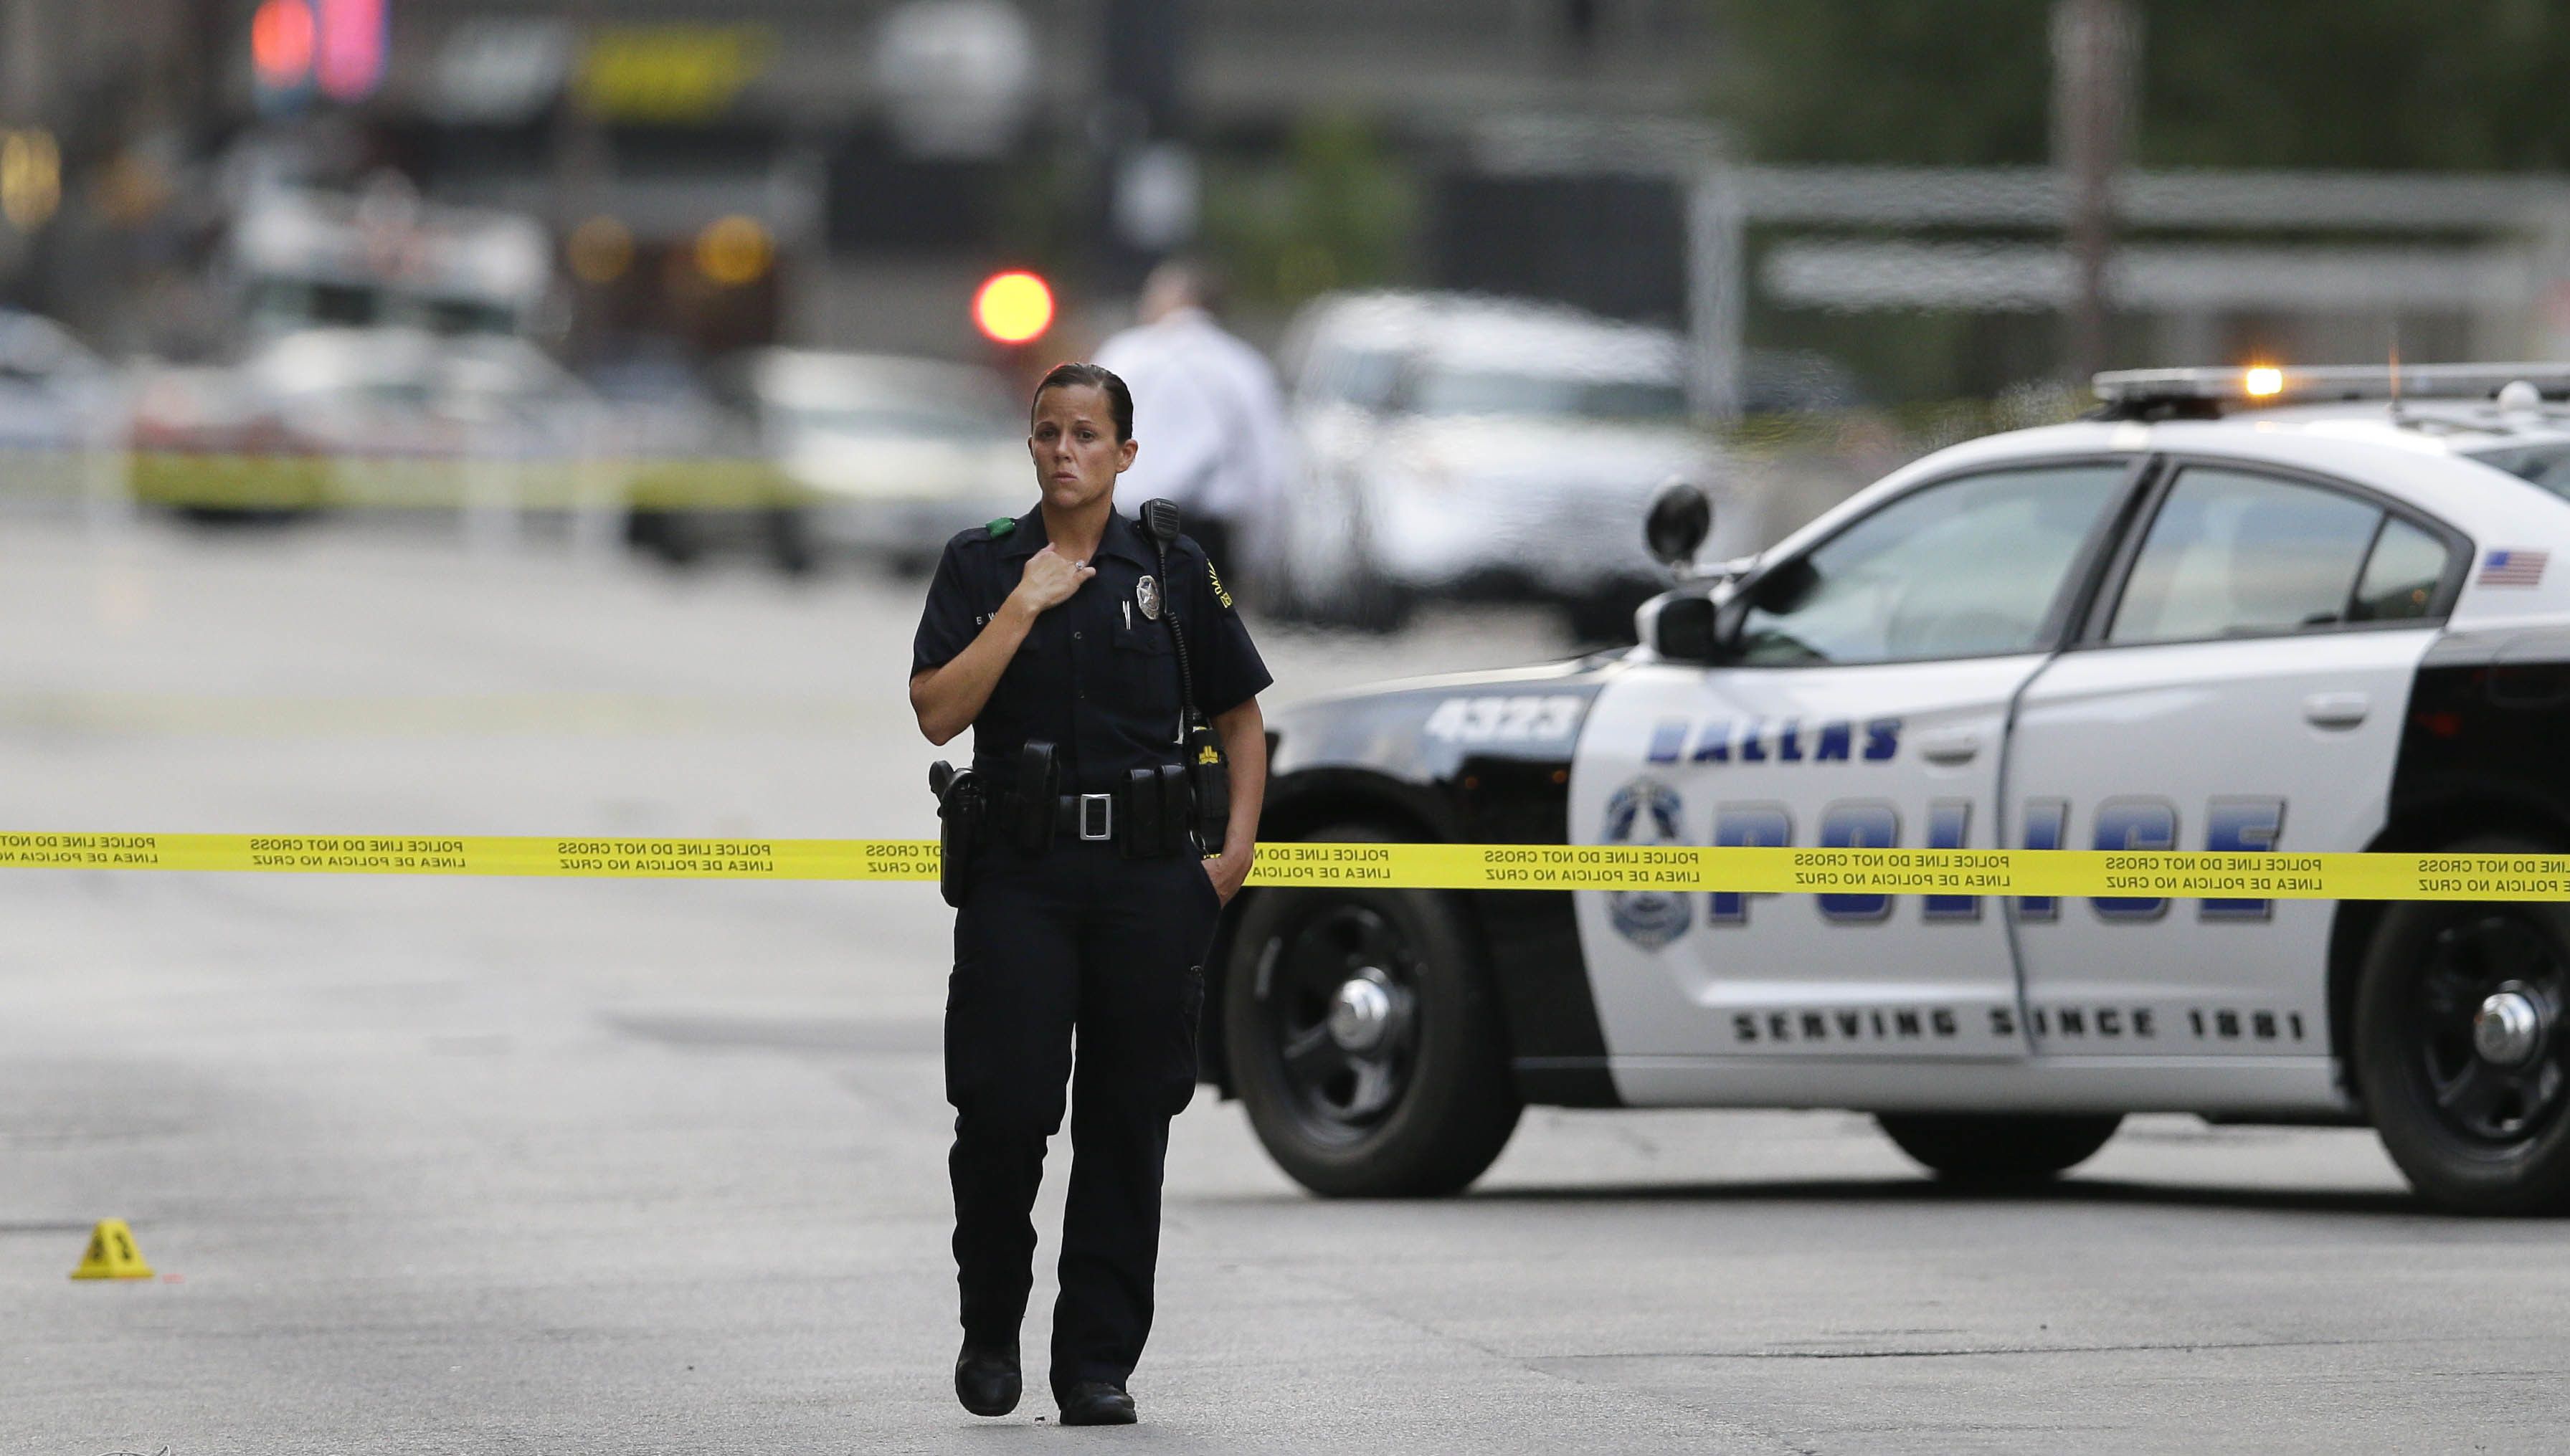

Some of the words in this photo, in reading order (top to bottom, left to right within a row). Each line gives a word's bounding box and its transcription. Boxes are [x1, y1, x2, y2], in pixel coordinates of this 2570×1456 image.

[1424, 696, 1582, 741] 4323
[1646, 718, 1902, 762] DALLAS
[1710, 796, 2287, 925] POLICE
[1734, 1008, 1957, 1040] SERVING
[1990, 1007, 2153, 1039] SINCE
[2190, 1007, 2303, 1040] 1881
